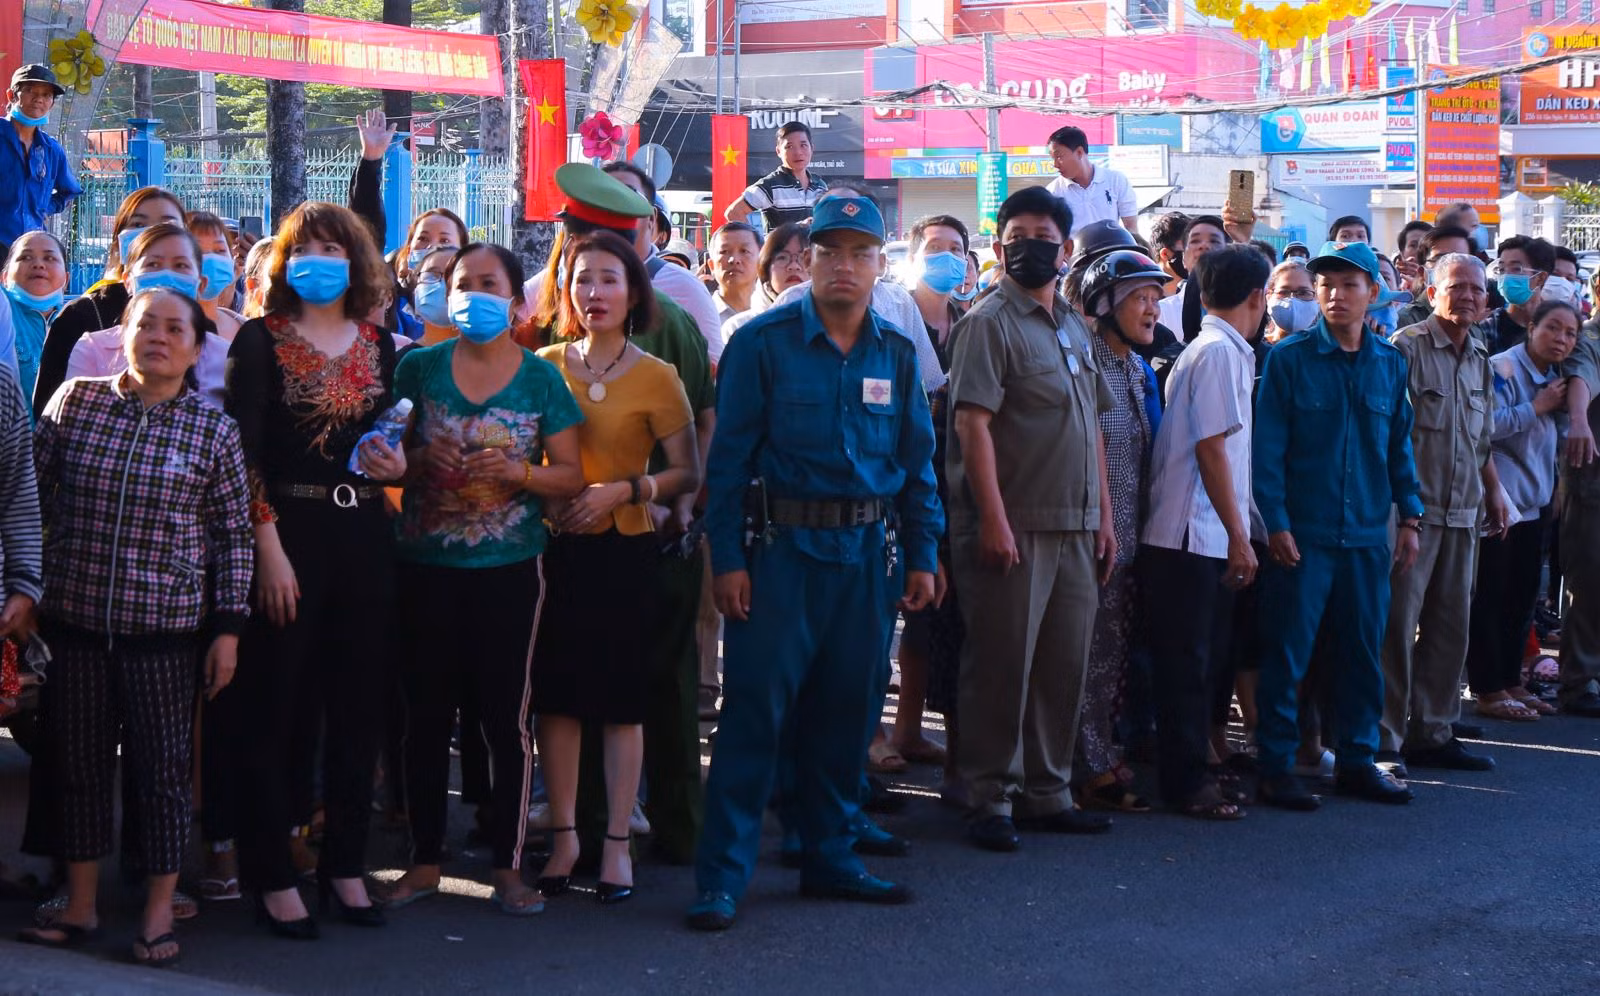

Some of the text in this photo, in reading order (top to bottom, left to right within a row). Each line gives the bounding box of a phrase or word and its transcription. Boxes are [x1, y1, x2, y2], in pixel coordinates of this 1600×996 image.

[141, 7, 153, 45] TỔ
[155, 12, 179, 48] QUỐC
[181, 18, 200, 56] VIỆT
[201, 25, 221, 54] NAM
[223, 23, 235, 56] XÃ
[237, 25, 251, 62] HỘI
[252, 24, 269, 58] CHỦ
[1119, 69, 1167, 94] Baby
[1536, 94, 1561, 111] DÁN
[1565, 97, 1590, 111] KEO
